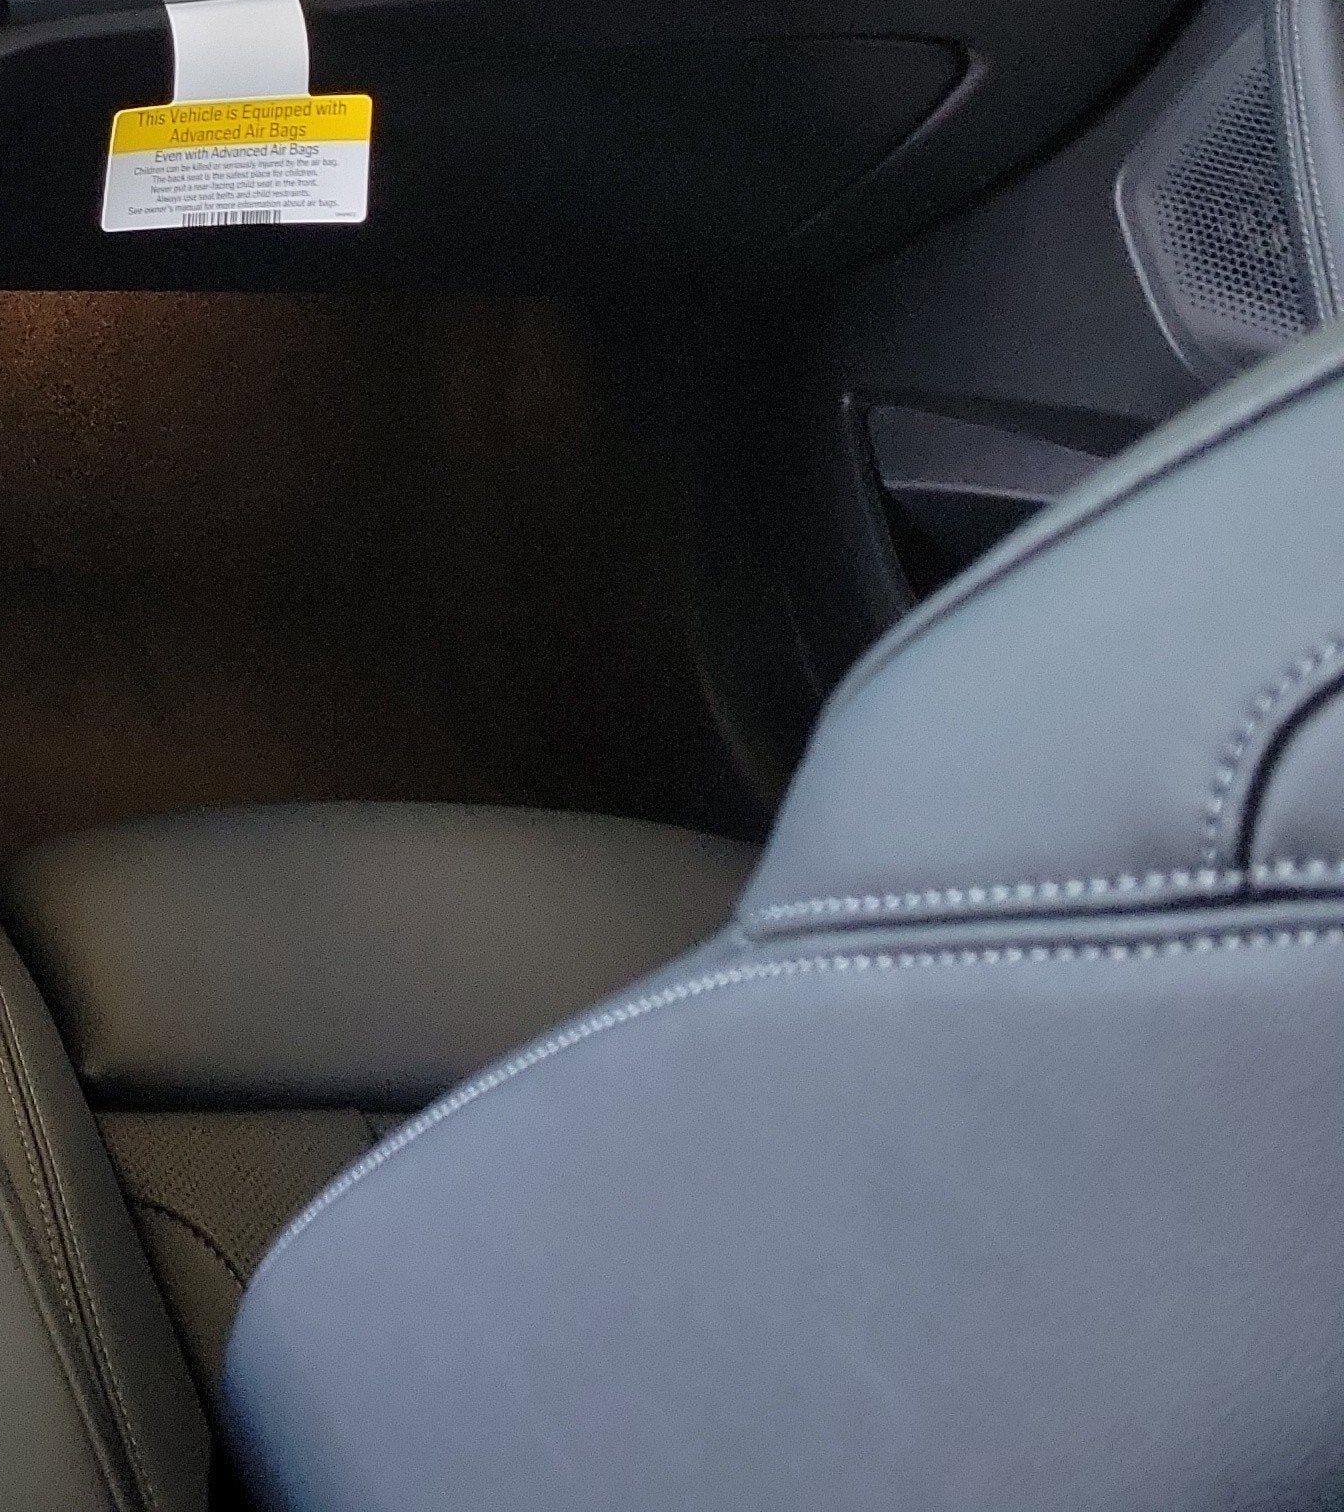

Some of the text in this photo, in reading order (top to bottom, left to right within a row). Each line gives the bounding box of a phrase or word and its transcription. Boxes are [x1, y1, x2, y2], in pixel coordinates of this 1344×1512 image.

[138, 99, 347, 127] This Vehicle is Equipped with
[170, 122, 307, 143] Advanced Air Bags
[155, 142, 319, 163] Even with Advanced Air Bags
